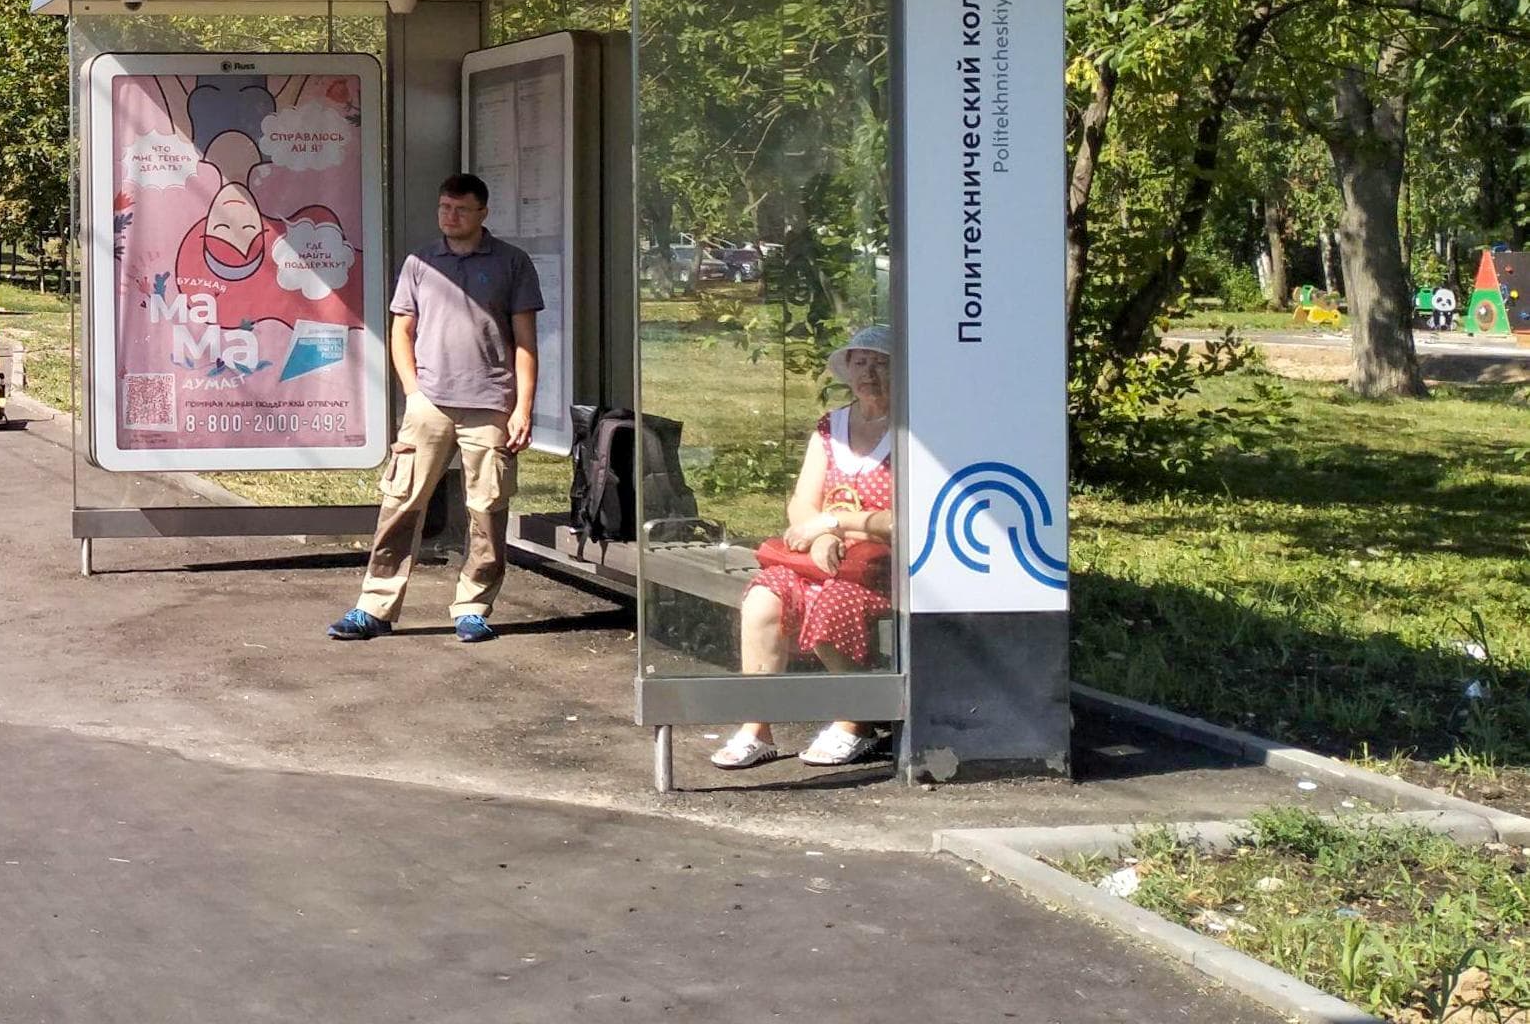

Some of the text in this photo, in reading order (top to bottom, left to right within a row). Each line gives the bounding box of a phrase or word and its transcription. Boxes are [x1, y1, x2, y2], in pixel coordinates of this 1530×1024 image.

[270, 132, 344, 142] СПРАВЛЮСЬ
[151, 145, 171, 153] ЧТО
[132, 154, 191, 162] МНЕ ТЕПЕРЬ
[957, 57, 982, 343] Политехнический
[177, 277, 227, 293] БУДУЩАЯ
[182, 373, 246, 390] ДУМАЕТ
[185, 414, 347, 432] 8-800-2000-492
